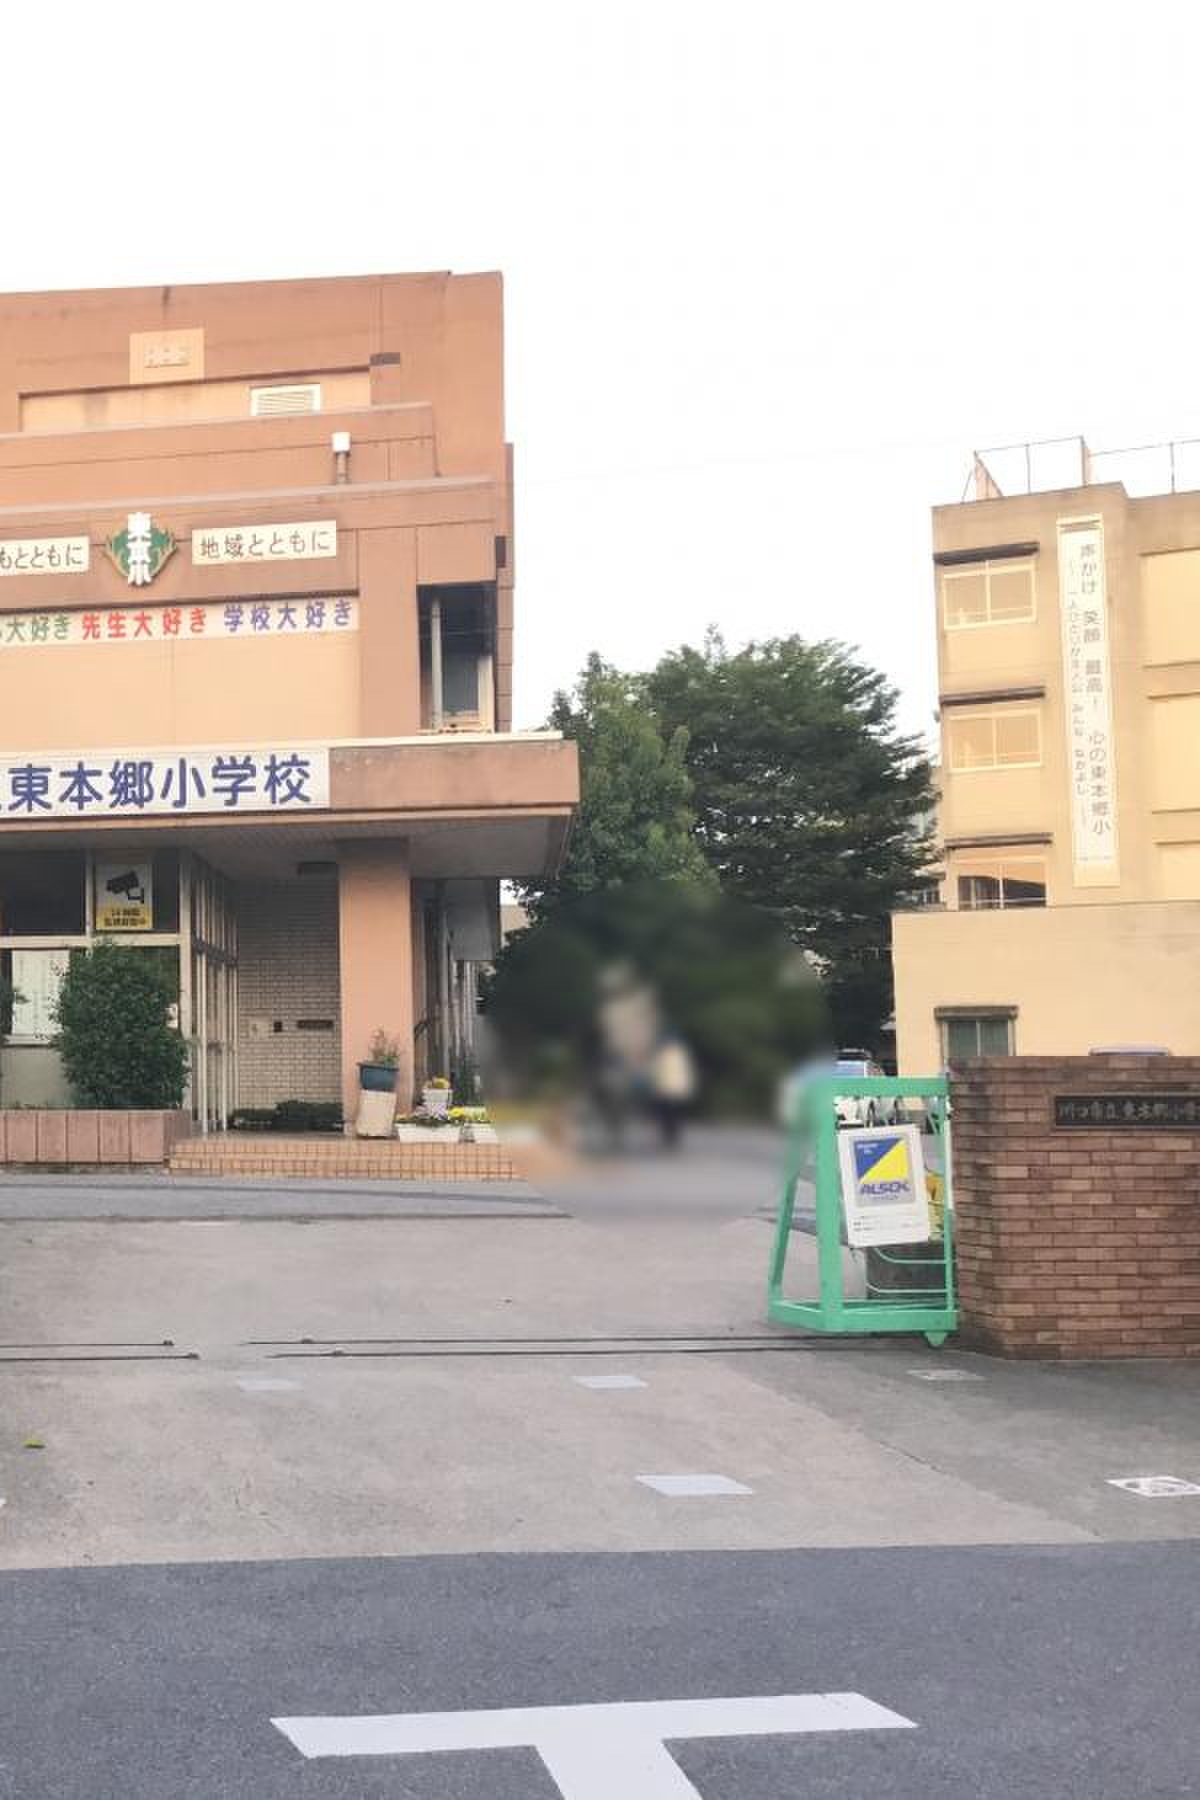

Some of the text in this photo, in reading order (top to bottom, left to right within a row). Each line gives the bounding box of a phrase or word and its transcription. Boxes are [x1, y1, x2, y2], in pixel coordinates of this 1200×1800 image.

[200, 529, 331, 559] 地域とともに
[81, 607, 207, 640] 先生大好き
[224, 599, 354, 633] 学校大好き
